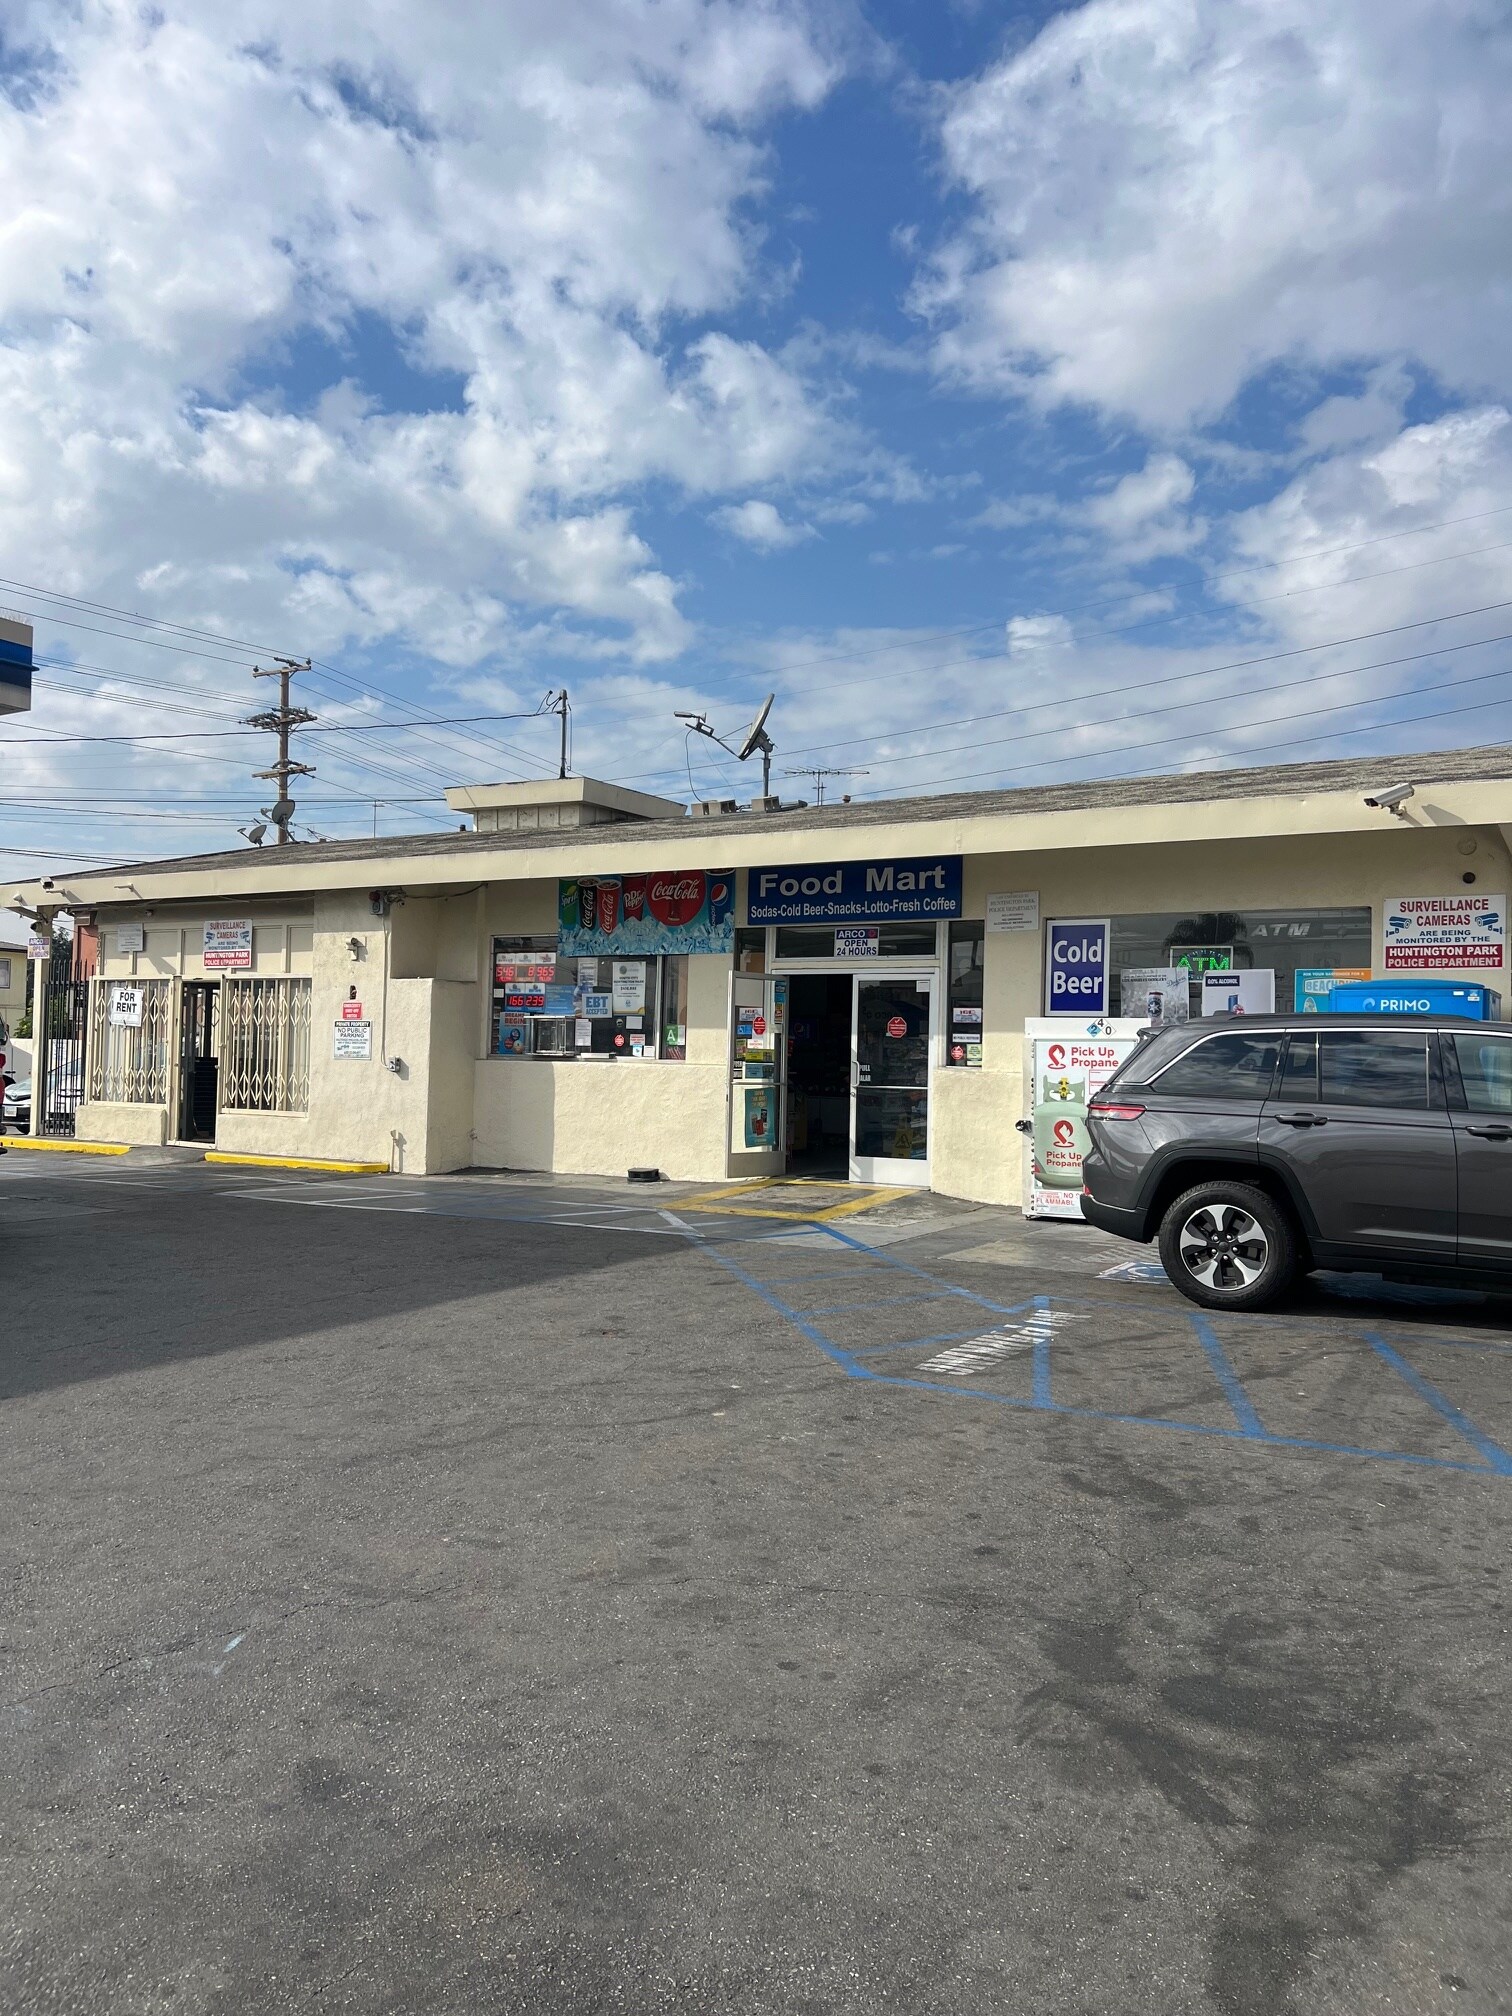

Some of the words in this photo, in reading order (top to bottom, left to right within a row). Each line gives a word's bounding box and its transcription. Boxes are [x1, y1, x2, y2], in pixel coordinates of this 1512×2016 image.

[760, 870, 842, 897] Food
[866, 865, 945, 892] Mart
[652, 879, 700, 900] Coca-Cola
[582, 890, 594, 928] Coca-Cola
[750, 904, 800, 918] Sodas-Cold
[923, 897, 956, 910] Coffee
[1400, 899, 1488, 912] SURVEILLANCE
[602, 892, 614, 933] Coca-Cola
[210, 921, 246, 930] SURVEILLANCE
[1417, 914, 1470, 926] CAMERAS
[217, 931, 238, 939] CAMERAS
[838, 930, 865, 938] ARCO
[1251, 923, 1311, 937] ATM
[849, 947, 876, 955] HOURS
[1054, 939, 1102, 962] Cold
[1390, 947, 1462, 956] HUNTINGTON
[1467, 946, 1498, 955] PARK
[1176, 956, 1229, 971] ATM
[1388, 958, 1425, 967] POLICE
[1428, 958, 1500, 966] DEPARTMENT
[1053, 971, 1102, 994] Beer
[120, 992, 135, 1002] FOR
[509, 996, 523, 1006] 166
[586, 996, 608, 1007] EBT
[116, 1002, 137, 1013] RENT
[1380, 999, 1430, 1011] PRIMO
[1098, 1019, 1104, 1027] 4
[667, 1030, 675, 1041] A
[1091, 1026, 1097, 1034] 2
[1105, 1026, 1112, 1035] 0
[1071, 1047, 1094, 1056] Pick
[1098, 1047, 1114, 1058] Up
[1071, 1058, 1119, 1068] Propane
[1046, 1151, 1065, 1159] Pick
[1069, 1152, 1082, 1160] Up
